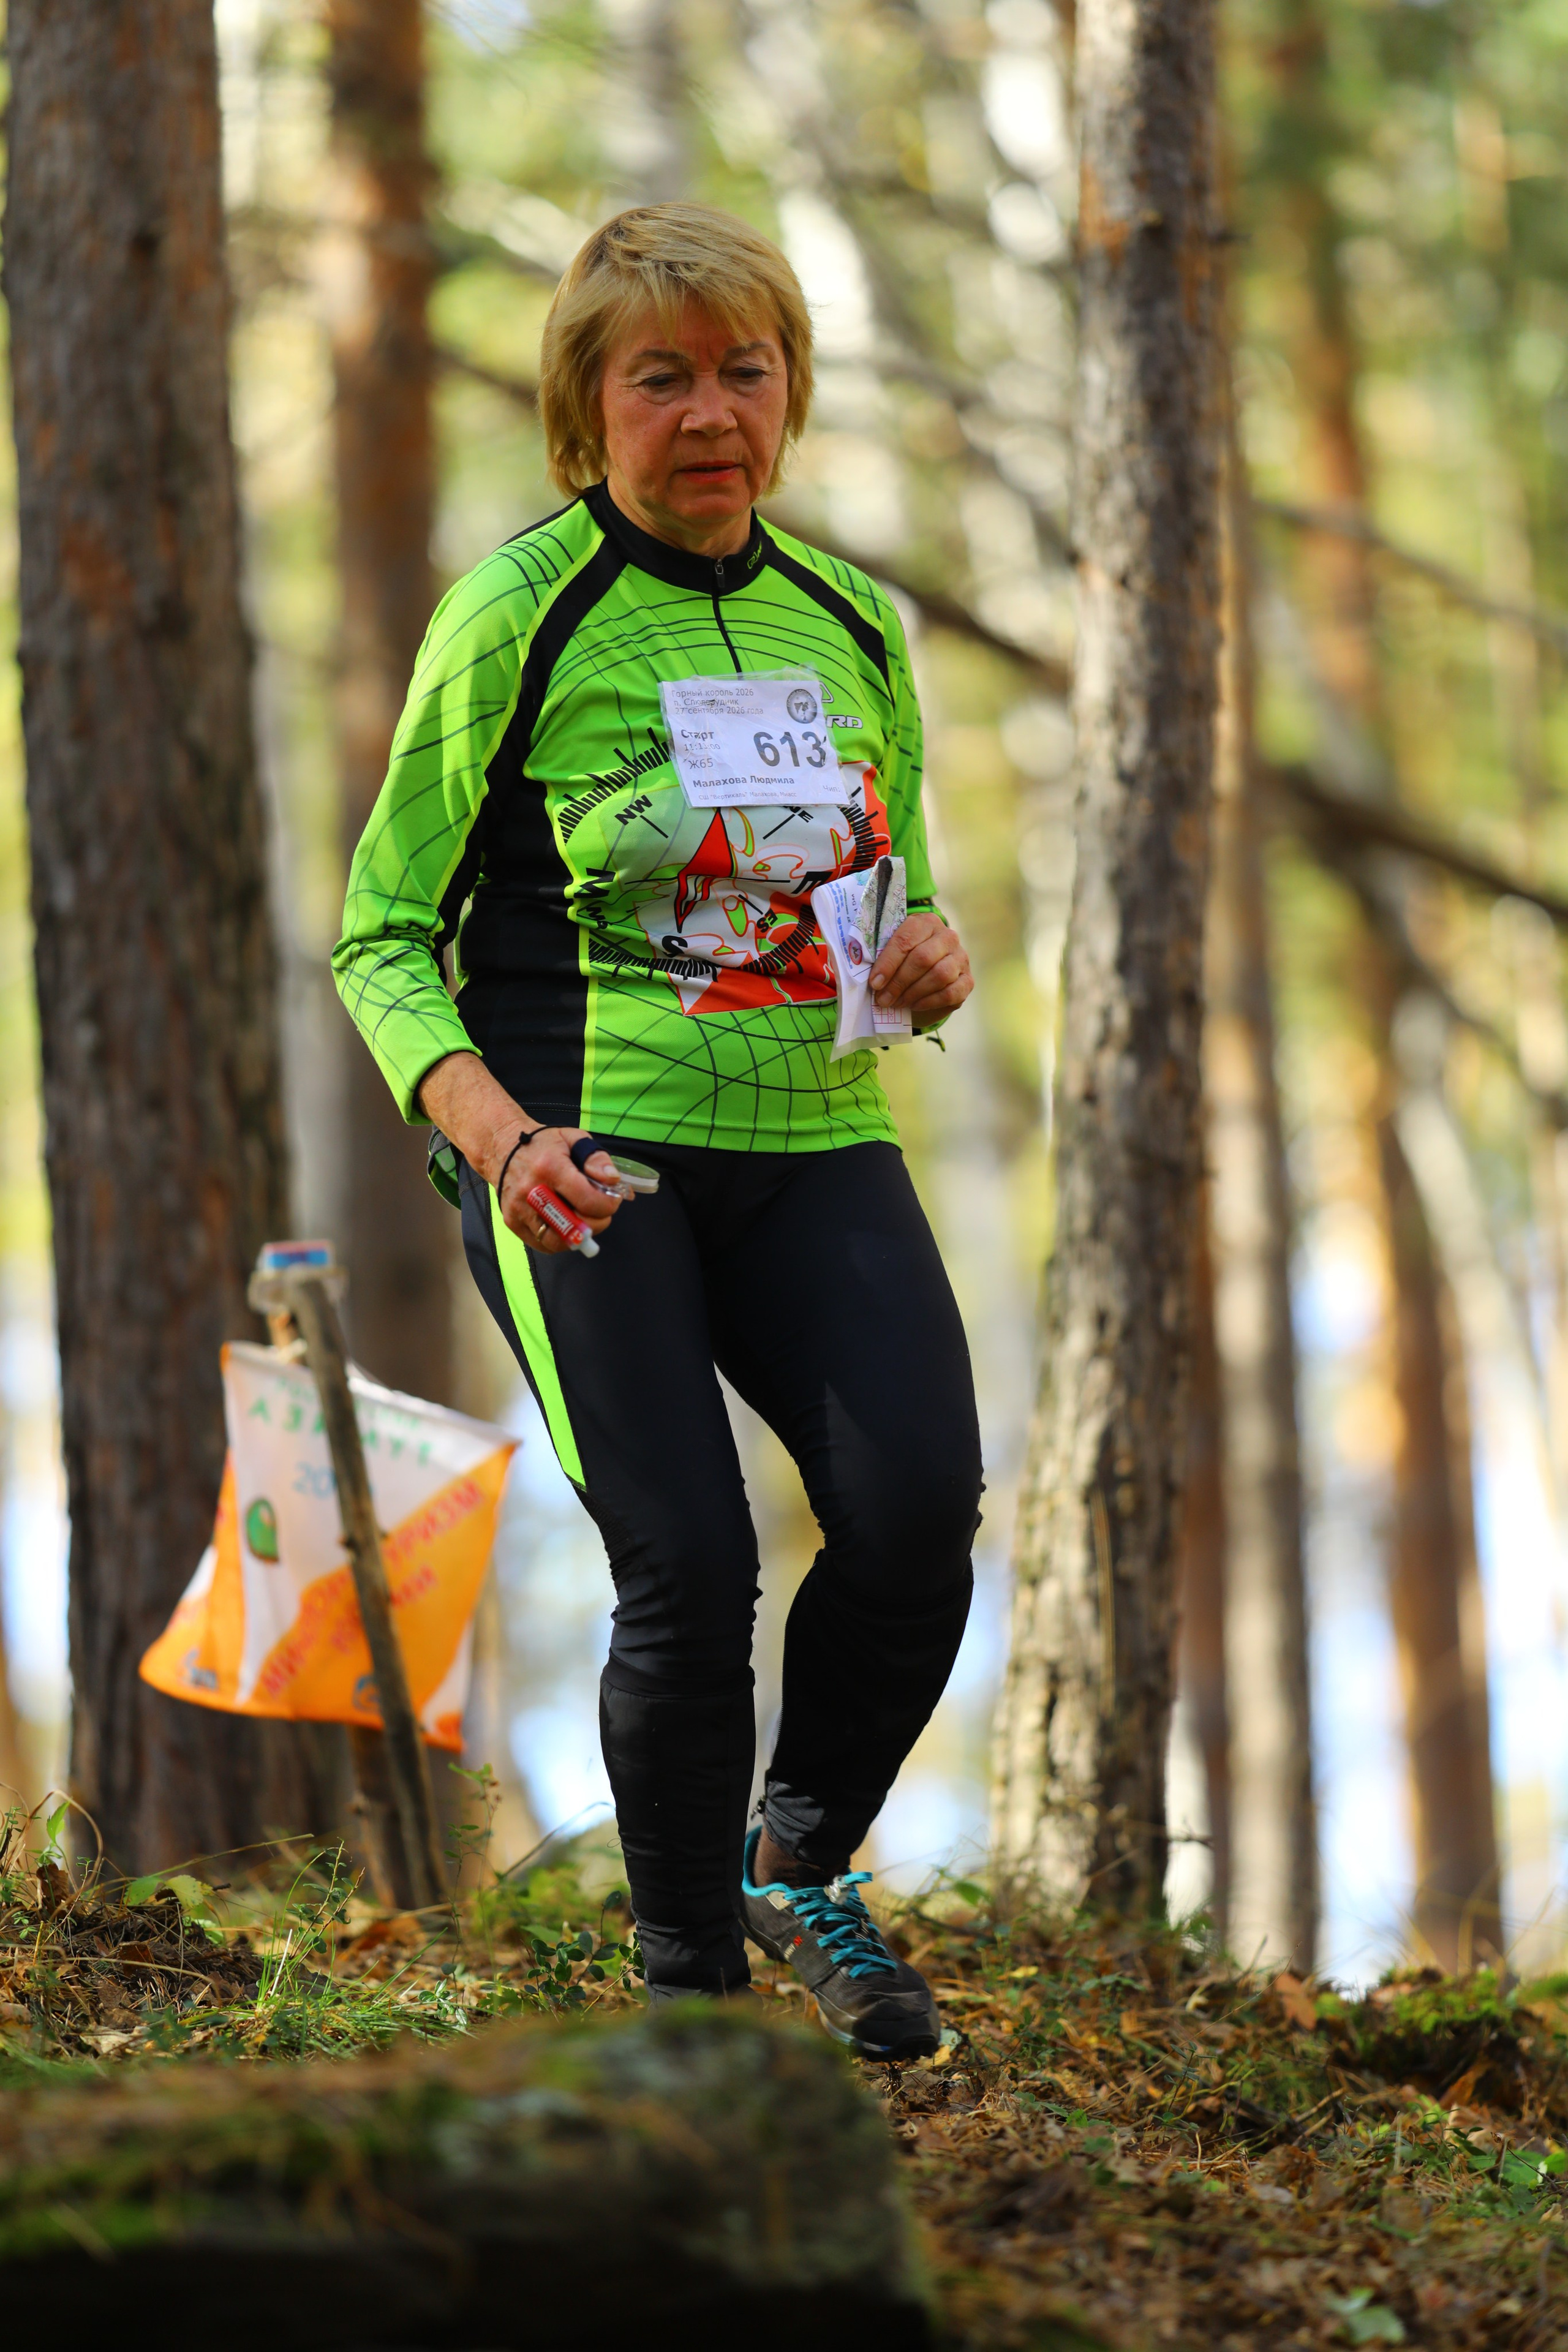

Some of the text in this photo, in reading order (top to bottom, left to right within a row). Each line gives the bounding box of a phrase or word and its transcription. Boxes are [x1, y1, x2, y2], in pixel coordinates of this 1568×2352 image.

[671, 689, 703, 698] Горный
[687, 707, 724, 715] сентября
[825, 714, 863, 729] RD
[680, 729, 715, 741] Старт
[753, 731, 826, 768] 613
[688, 758, 714, 769] Ж65
[693, 775, 795, 788] Малахова Людмила
[614, 794, 653, 826] NW
[791, 871, 834, 894] E
[662, 935, 688, 958] S
